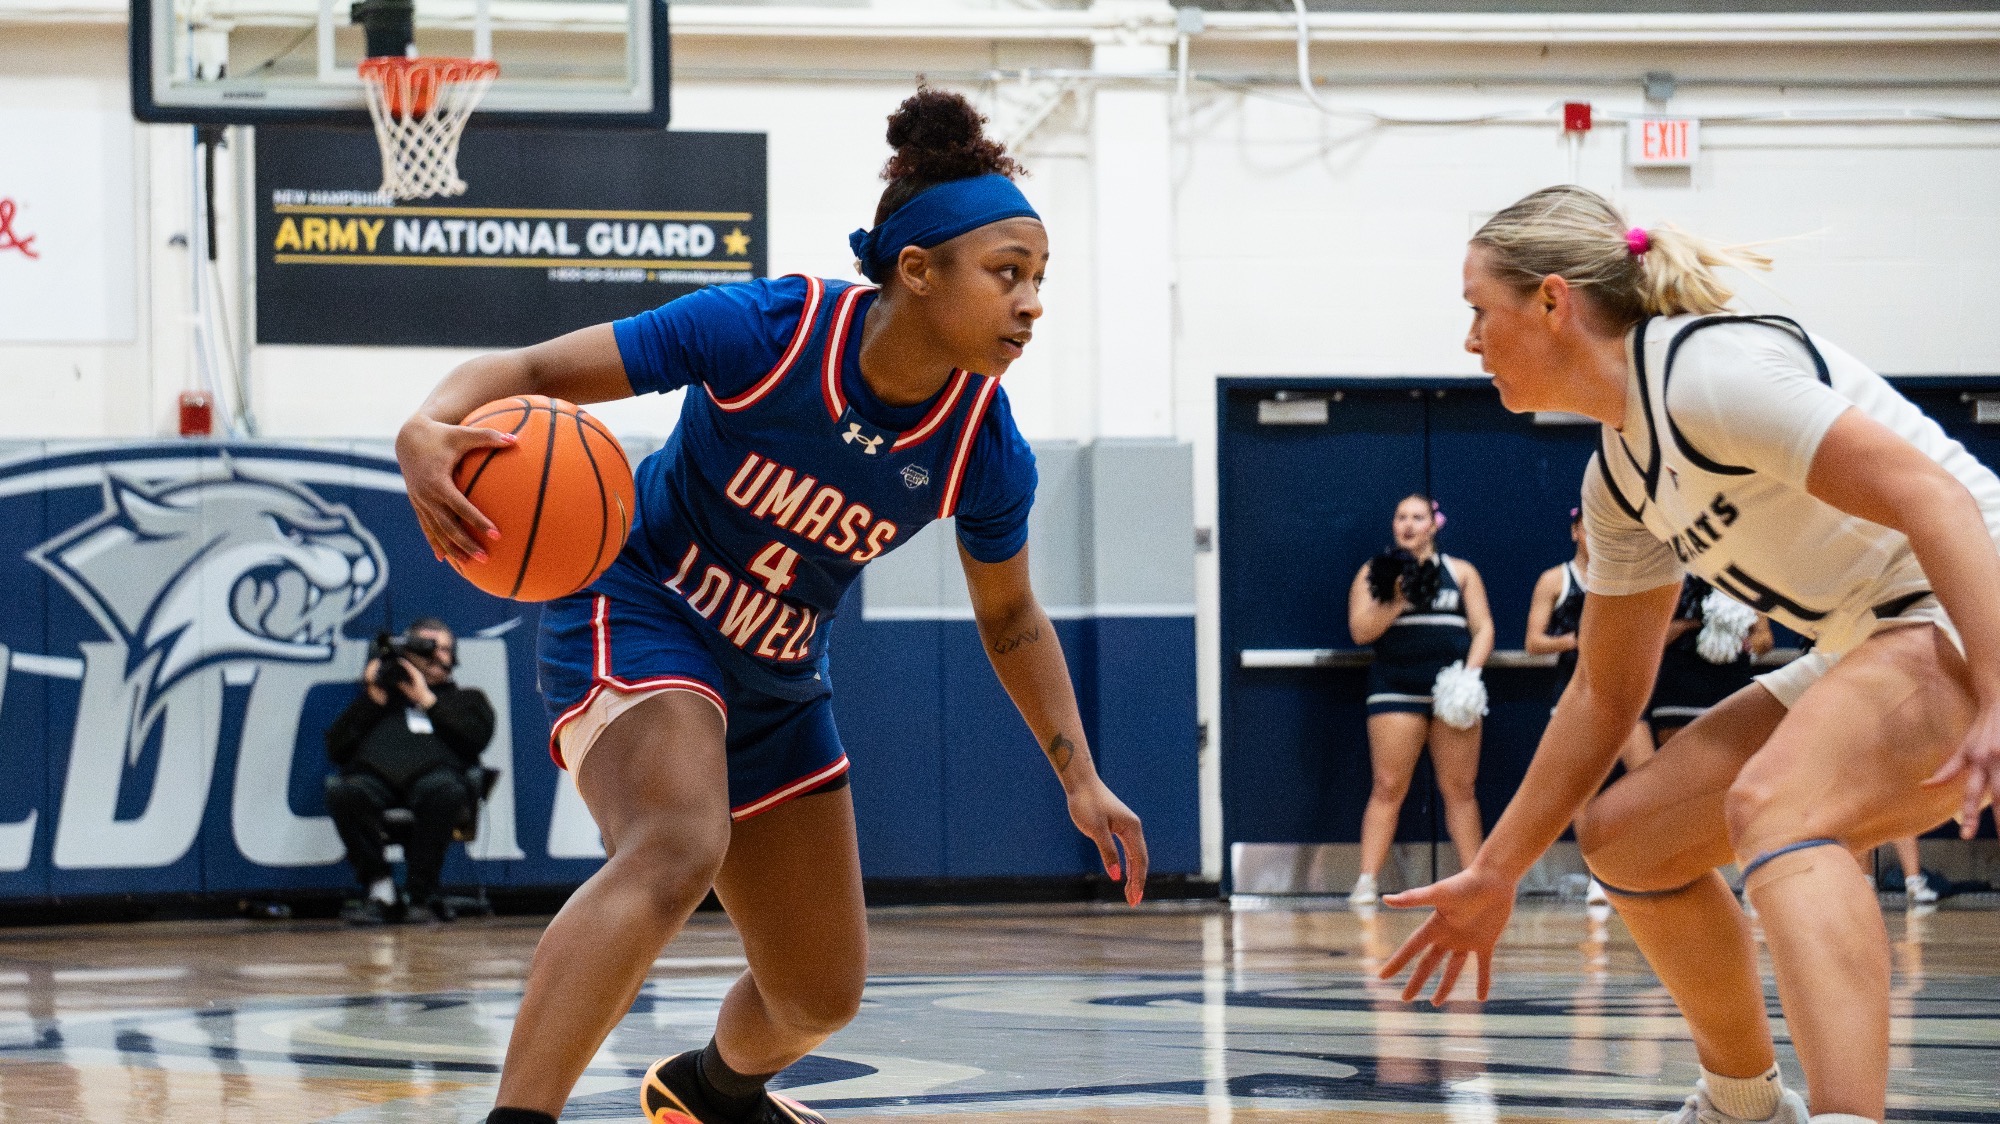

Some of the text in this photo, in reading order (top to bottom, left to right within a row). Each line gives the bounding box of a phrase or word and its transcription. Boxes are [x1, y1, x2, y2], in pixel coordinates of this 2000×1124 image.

[1643, 121, 1689, 158] EXIT
[275, 217, 716, 258] ARMY NATIONAL GUARD
[725, 451, 898, 564] UMASS
[746, 540, 801, 595] 4
[663, 541, 820, 662] LOWELL
